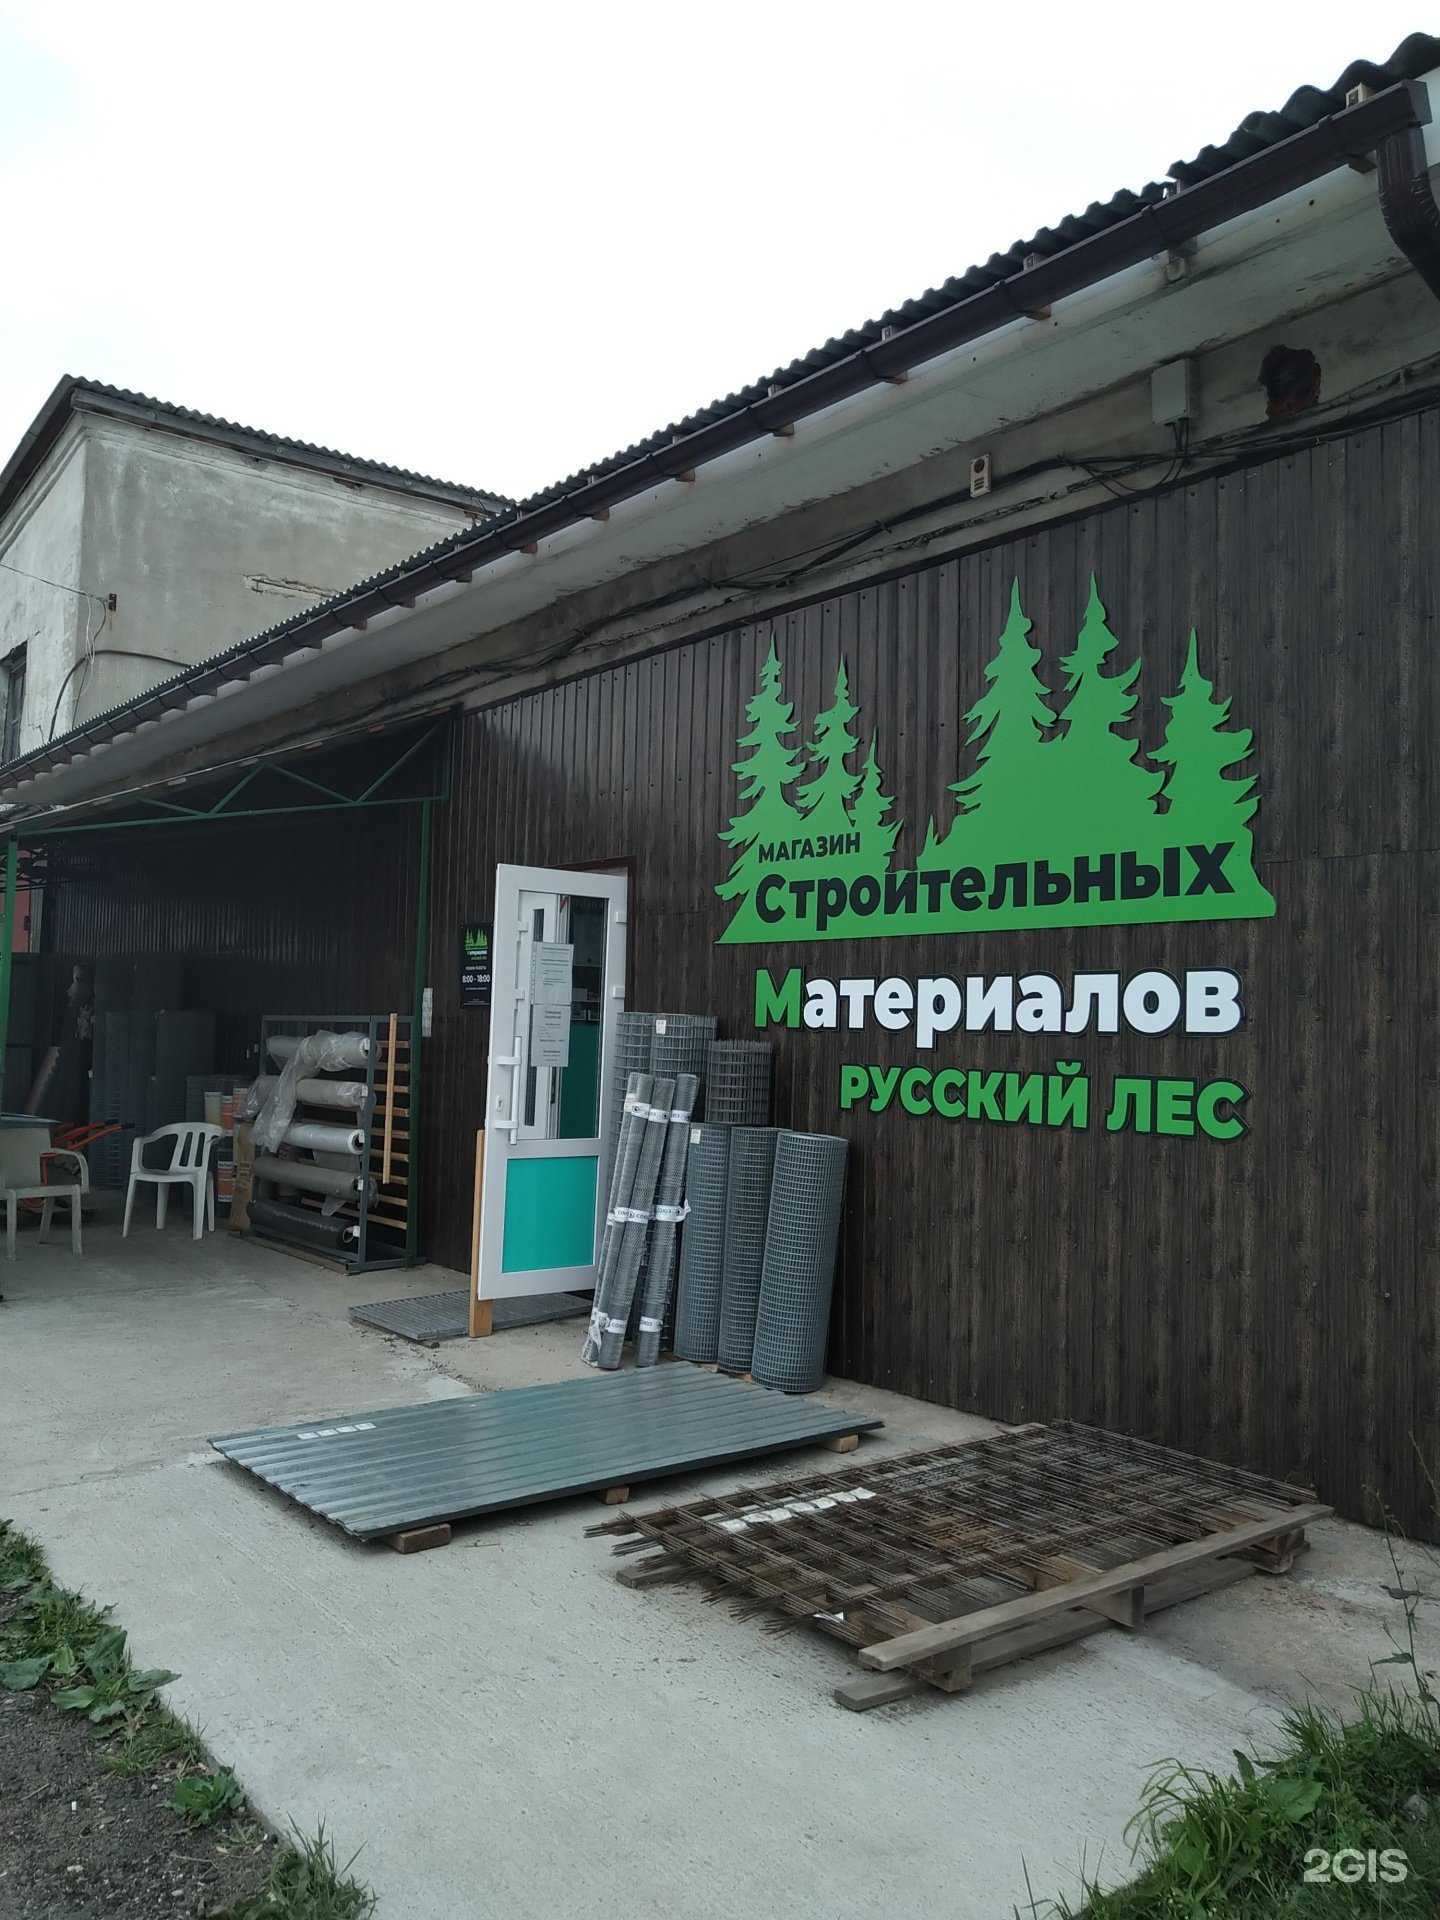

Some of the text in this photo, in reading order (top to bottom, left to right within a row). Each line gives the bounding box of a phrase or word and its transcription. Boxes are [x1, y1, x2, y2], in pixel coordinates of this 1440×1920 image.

[756, 841, 1236, 931] Строительных
[758, 832, 861, 863] МАГАЗИН
[462, 975, 474, 983] 8:00
[755, 968, 1243, 1049] Материалов
[840, 1061, 1250, 1140] РУССКИЙ ЛЕС
